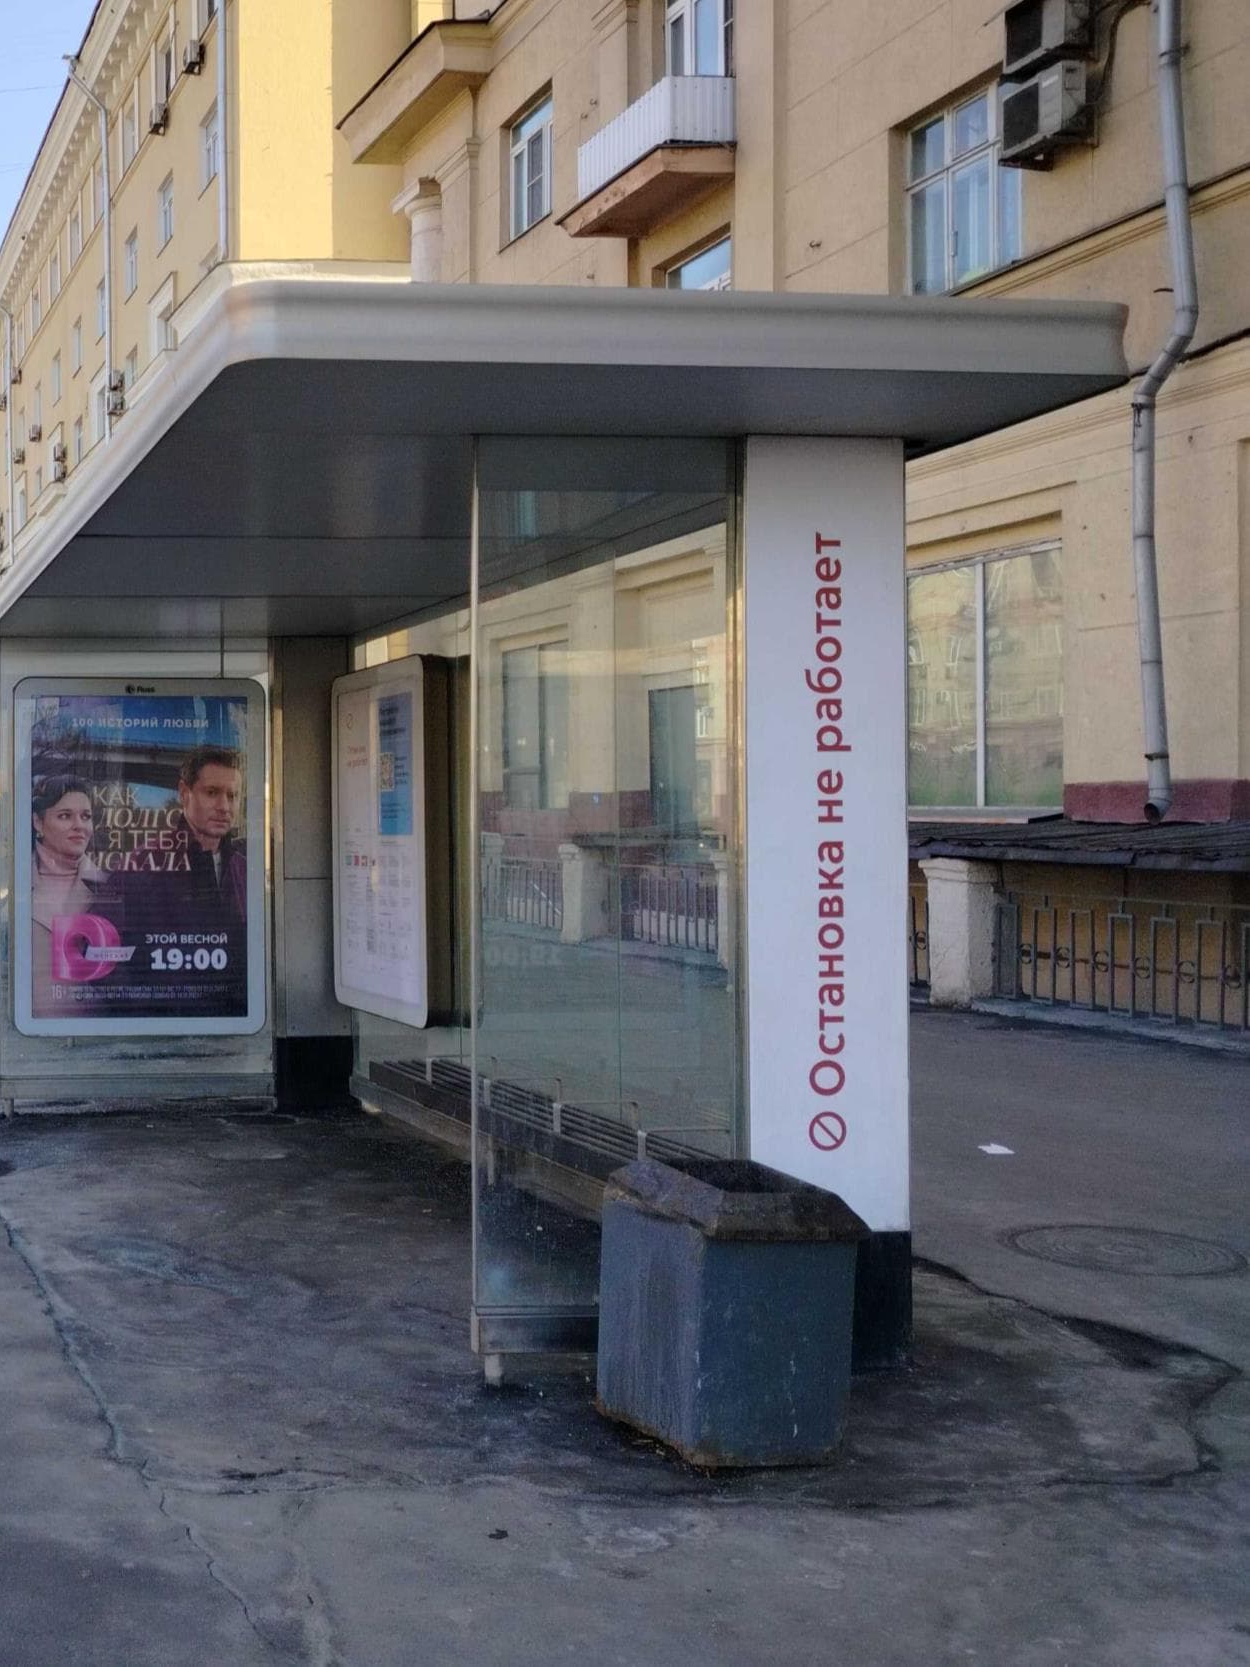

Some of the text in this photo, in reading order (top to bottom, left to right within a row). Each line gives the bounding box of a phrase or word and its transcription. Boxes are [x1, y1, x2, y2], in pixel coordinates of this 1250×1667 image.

[71, 716, 209, 728] 100 ИСТОРИЙ ЛЮБВИ
[93, 785, 140, 806] КАК
[804, 532, 852, 1096] Остановка не работает
[108, 830, 189, 850] Я ТЕБЯ
[85, 851, 191, 872] ИСКАЛА
[145, 932, 228, 944] ЭТОЙ ВЕСНОЙ
[150, 948, 228, 970] 19:00
